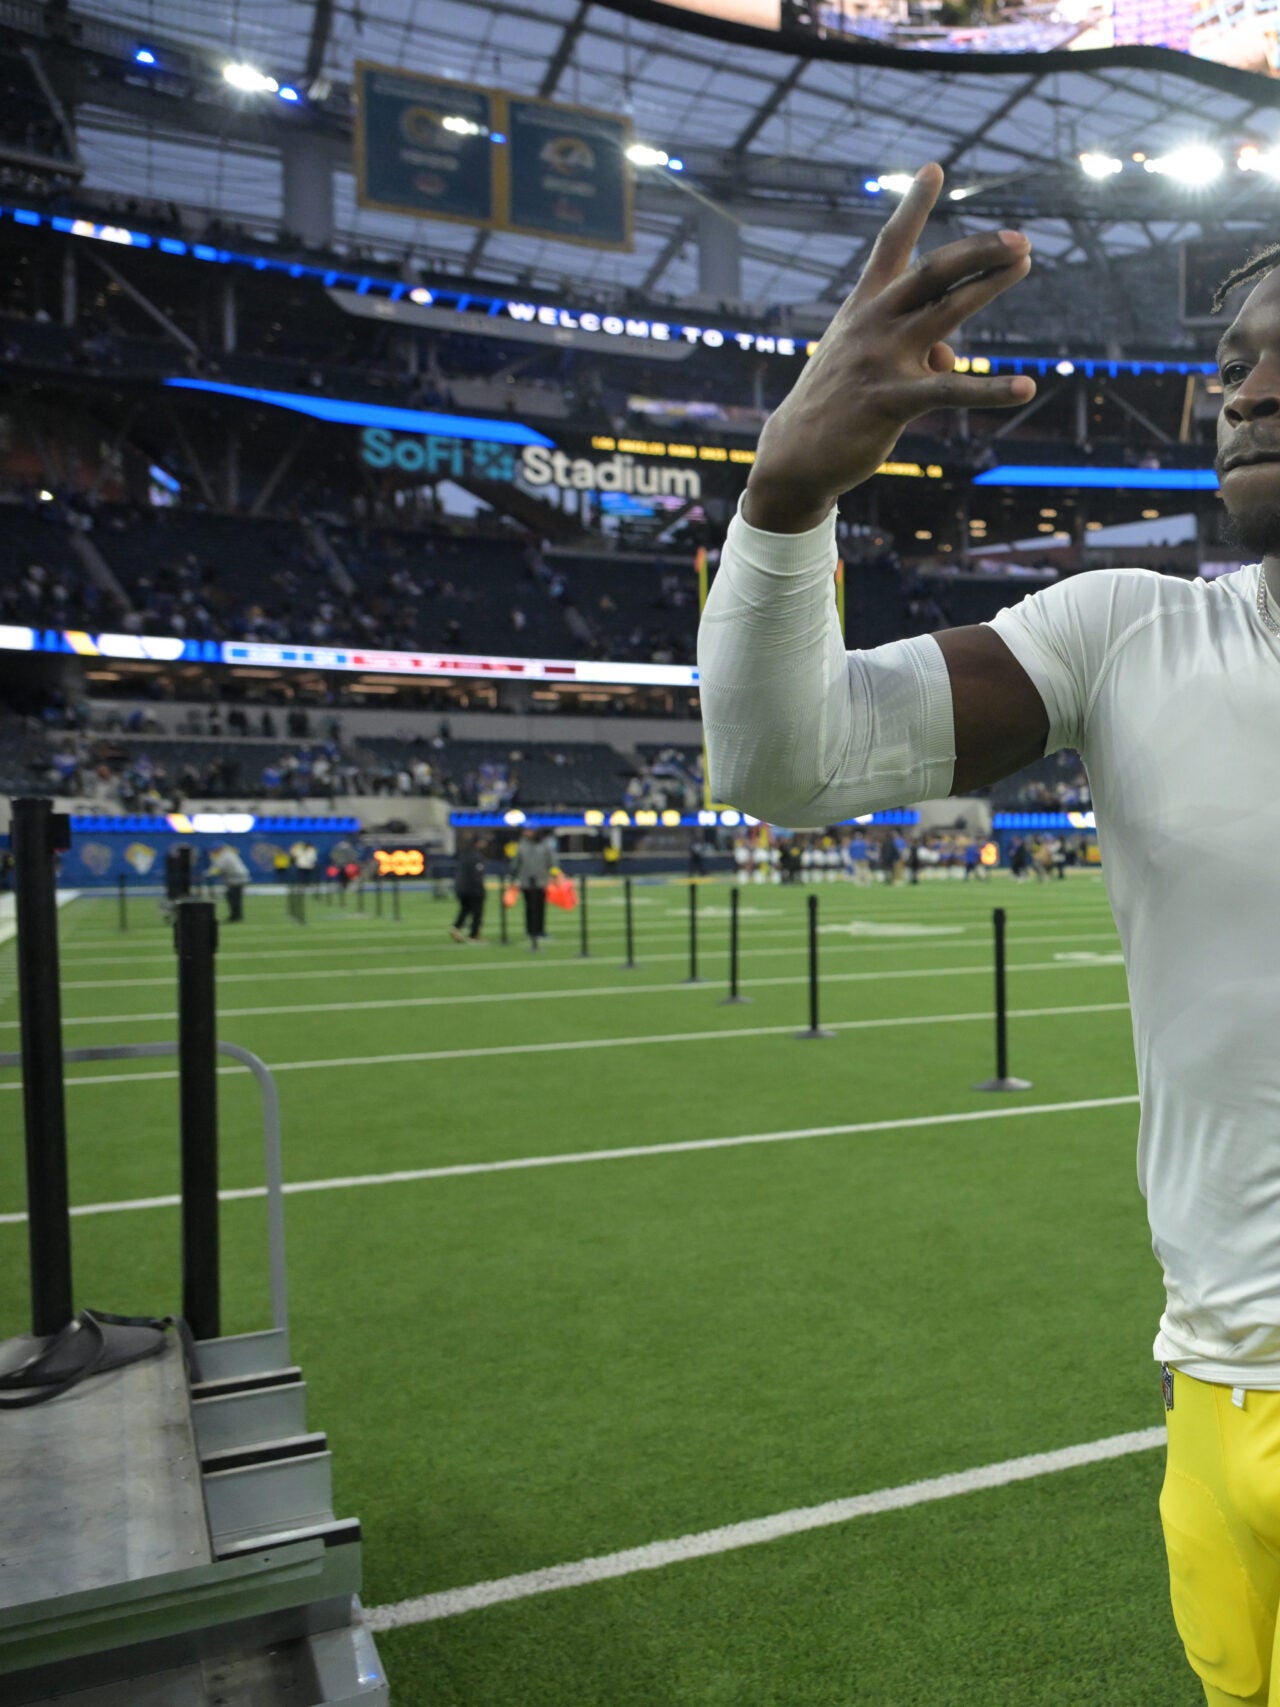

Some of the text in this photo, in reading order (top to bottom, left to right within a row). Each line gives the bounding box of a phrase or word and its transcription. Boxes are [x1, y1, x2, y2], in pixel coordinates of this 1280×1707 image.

[508, 302, 671, 341] WELCOME
[681, 326, 724, 347] TO
[735, 332, 796, 356] THE
[361, 427, 700, 499] SoFi Stadium
[584, 809, 761, 827] RAMS HOU
